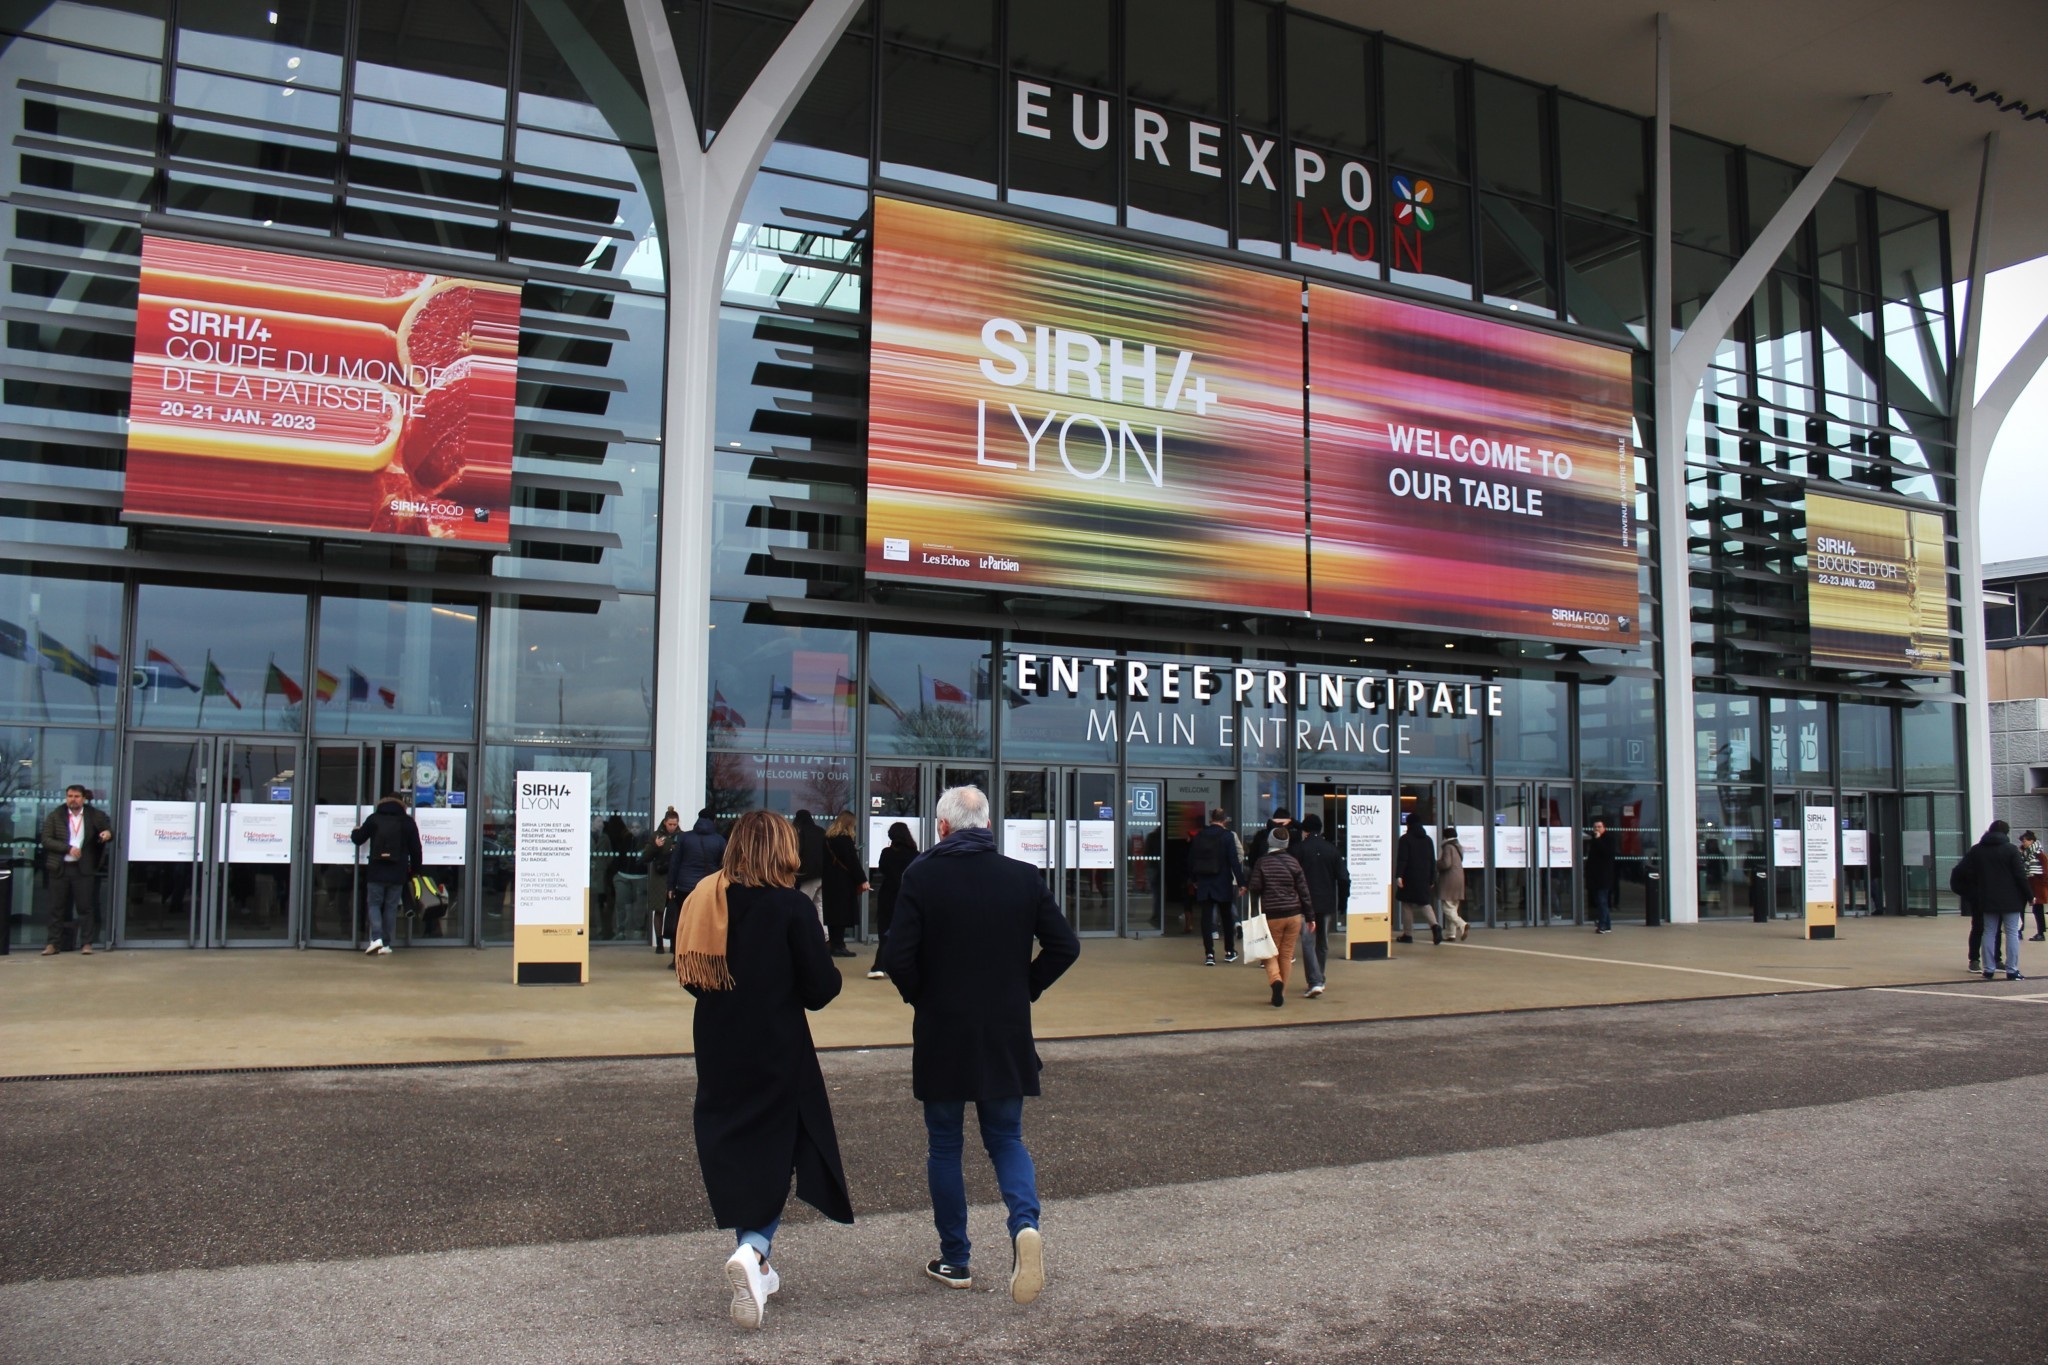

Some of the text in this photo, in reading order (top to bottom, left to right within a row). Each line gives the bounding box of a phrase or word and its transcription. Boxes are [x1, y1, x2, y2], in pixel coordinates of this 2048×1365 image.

[1017, 80, 1373, 211] EUREXPO
[1296, 200, 1423, 273] LYON
[166, 336, 447, 391] COUPE DU MONDE
[163, 367, 206, 395] DE
[215, 372, 253, 400] LA
[160, 401, 316, 430] 20-21 JAN. 2023
[977, 400, 1164, 488] LYON
[1387, 423, 1573, 480] WELCOME TO
[1388, 467, 1543, 517] OUR TABLE
[430, 503, 464, 516] FOOD
[988, 555, 1020, 572] Parisien
[1817, 554, 1897, 579] BOCUSE D'OR
[1818, 574, 1875, 590] 22-23 JAN. 2023
[1583, 612, 1610, 625] FOOD
[1018, 653, 1502, 717] ENTREE PRINCIPALE
[1086, 708, 1411, 754] MAIN ENTRANCE
[756, 769, 849, 781] WELCOME TO OUR
[521, 797, 560, 810] LYON
[1179, 786, 1210, 794] WELCOME
[1350, 815, 1374, 826] LYON
[1807, 823, 1823, 831] LYON
